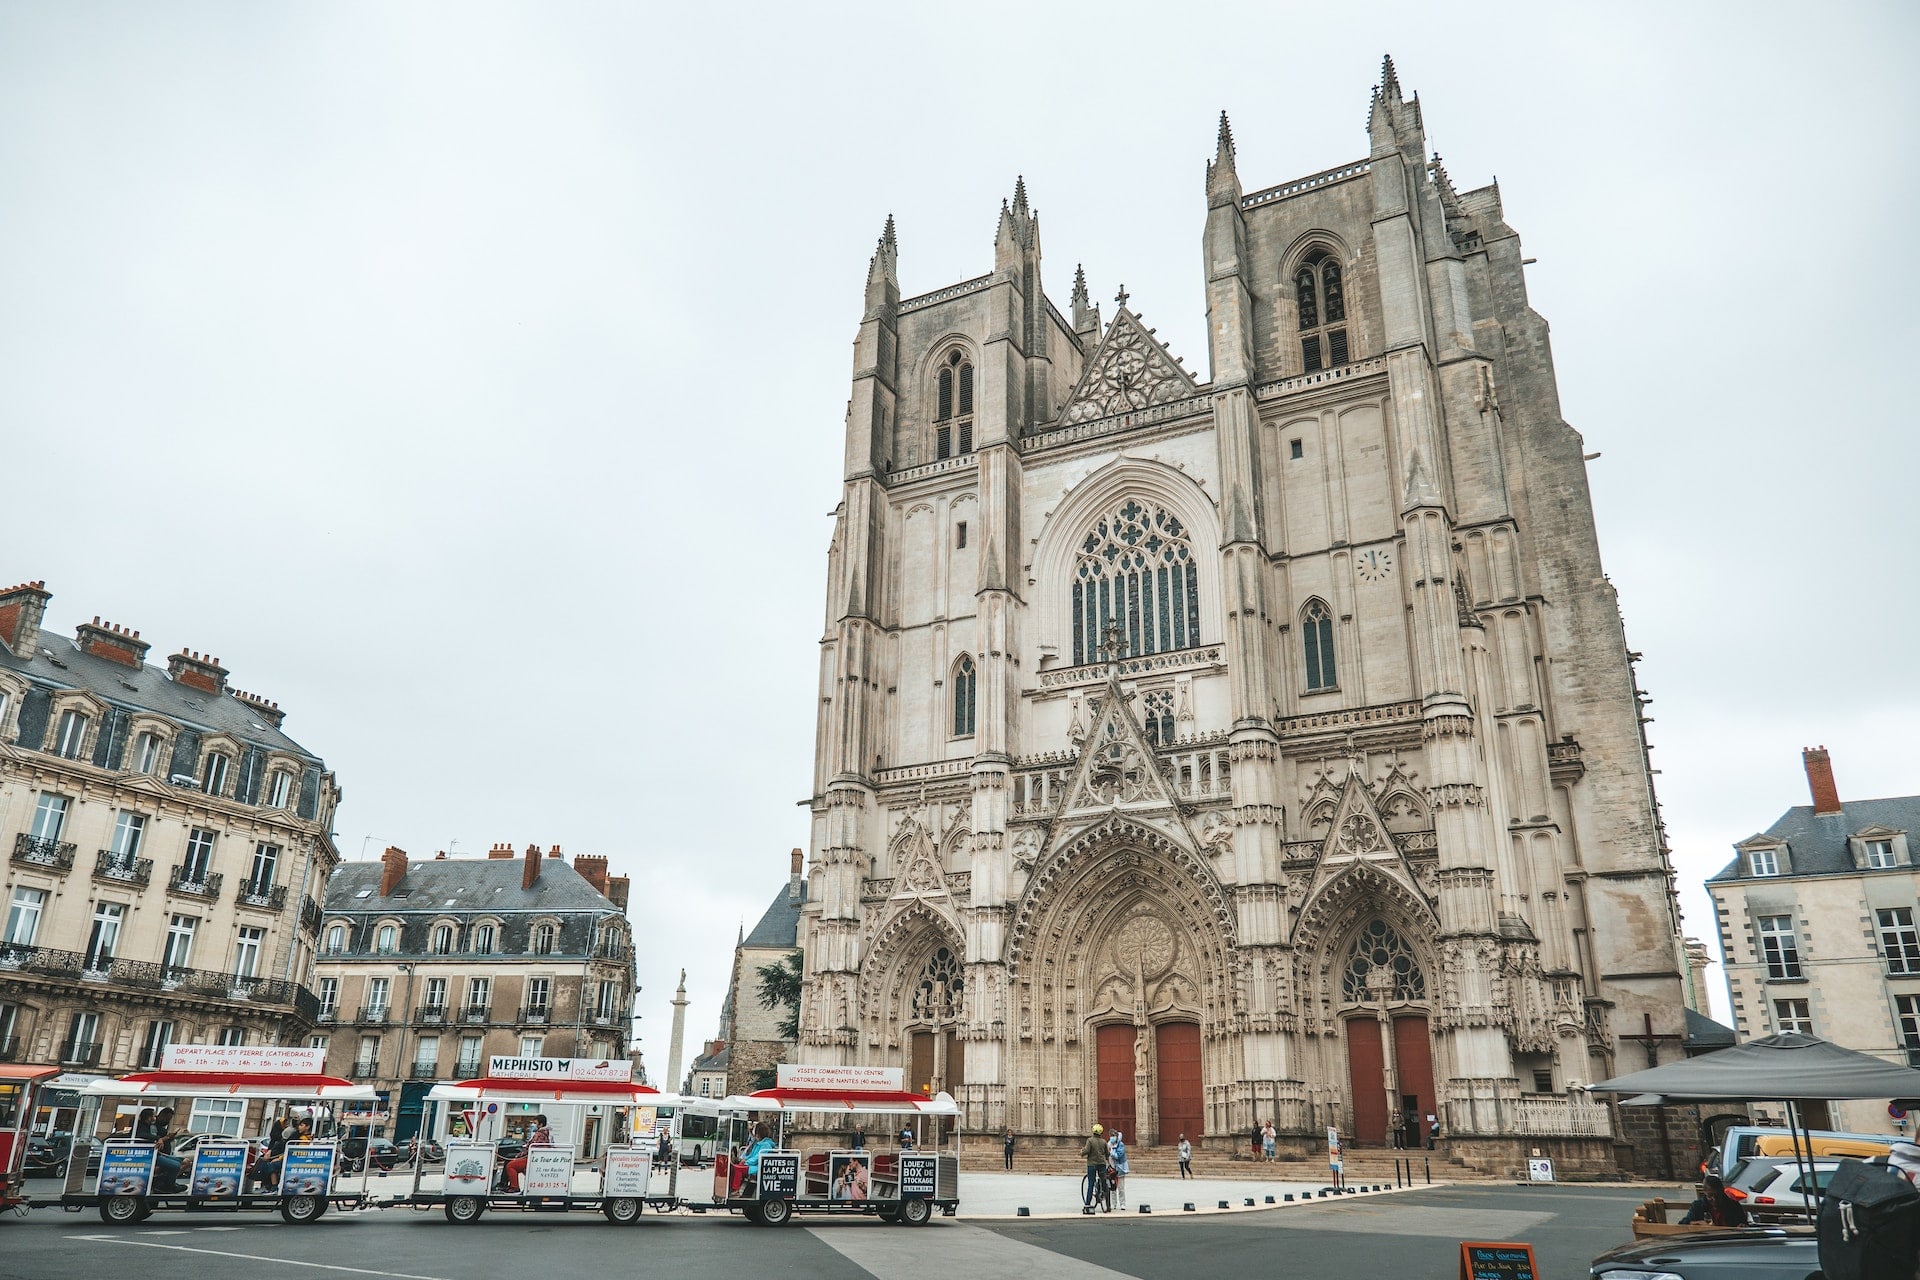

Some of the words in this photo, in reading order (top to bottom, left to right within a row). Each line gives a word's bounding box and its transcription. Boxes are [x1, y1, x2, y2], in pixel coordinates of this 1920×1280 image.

[492, 1059, 553, 1071] MEPHISTO
[904, 1168, 922, 1176] BOX
[763, 1181, 781, 1191] VIE
